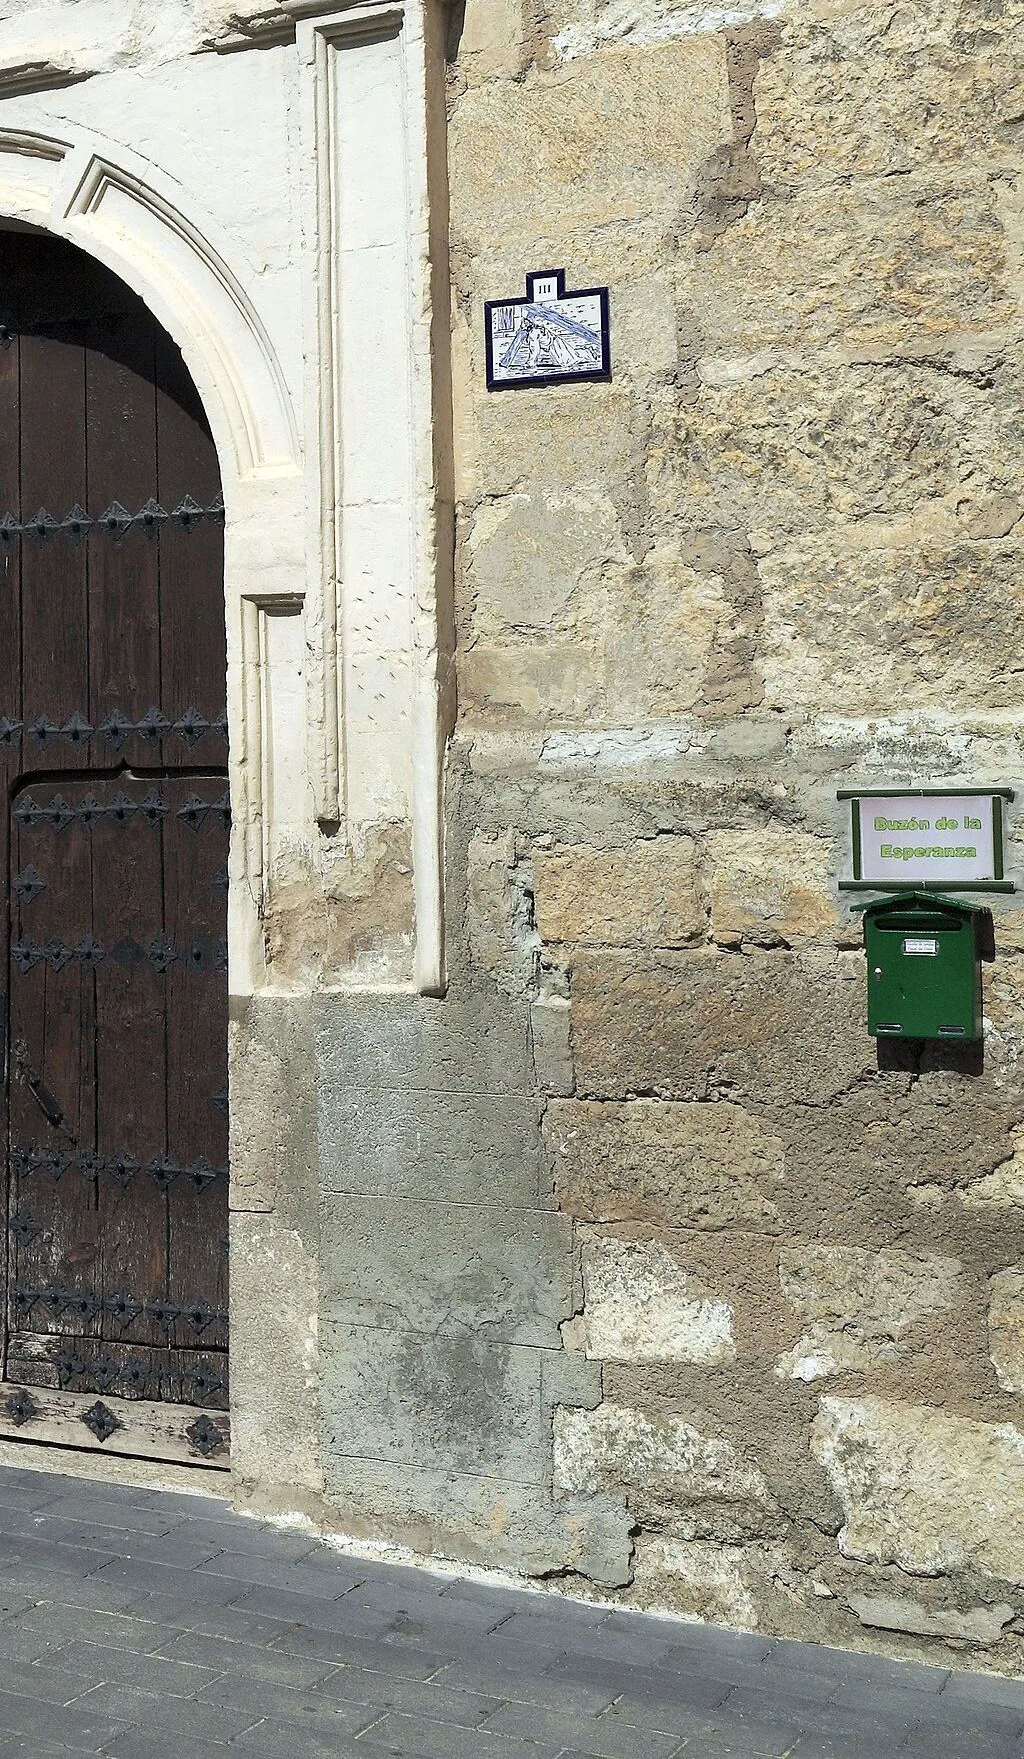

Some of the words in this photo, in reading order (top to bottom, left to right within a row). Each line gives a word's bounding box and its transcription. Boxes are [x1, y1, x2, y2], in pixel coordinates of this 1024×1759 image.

[538, 284, 551, 294] III
[874, 817, 930, 831] Buzón
[935, 816, 959, 831] de
[963, 816, 982, 830] la
[880, 844, 977, 861] Esperanza
